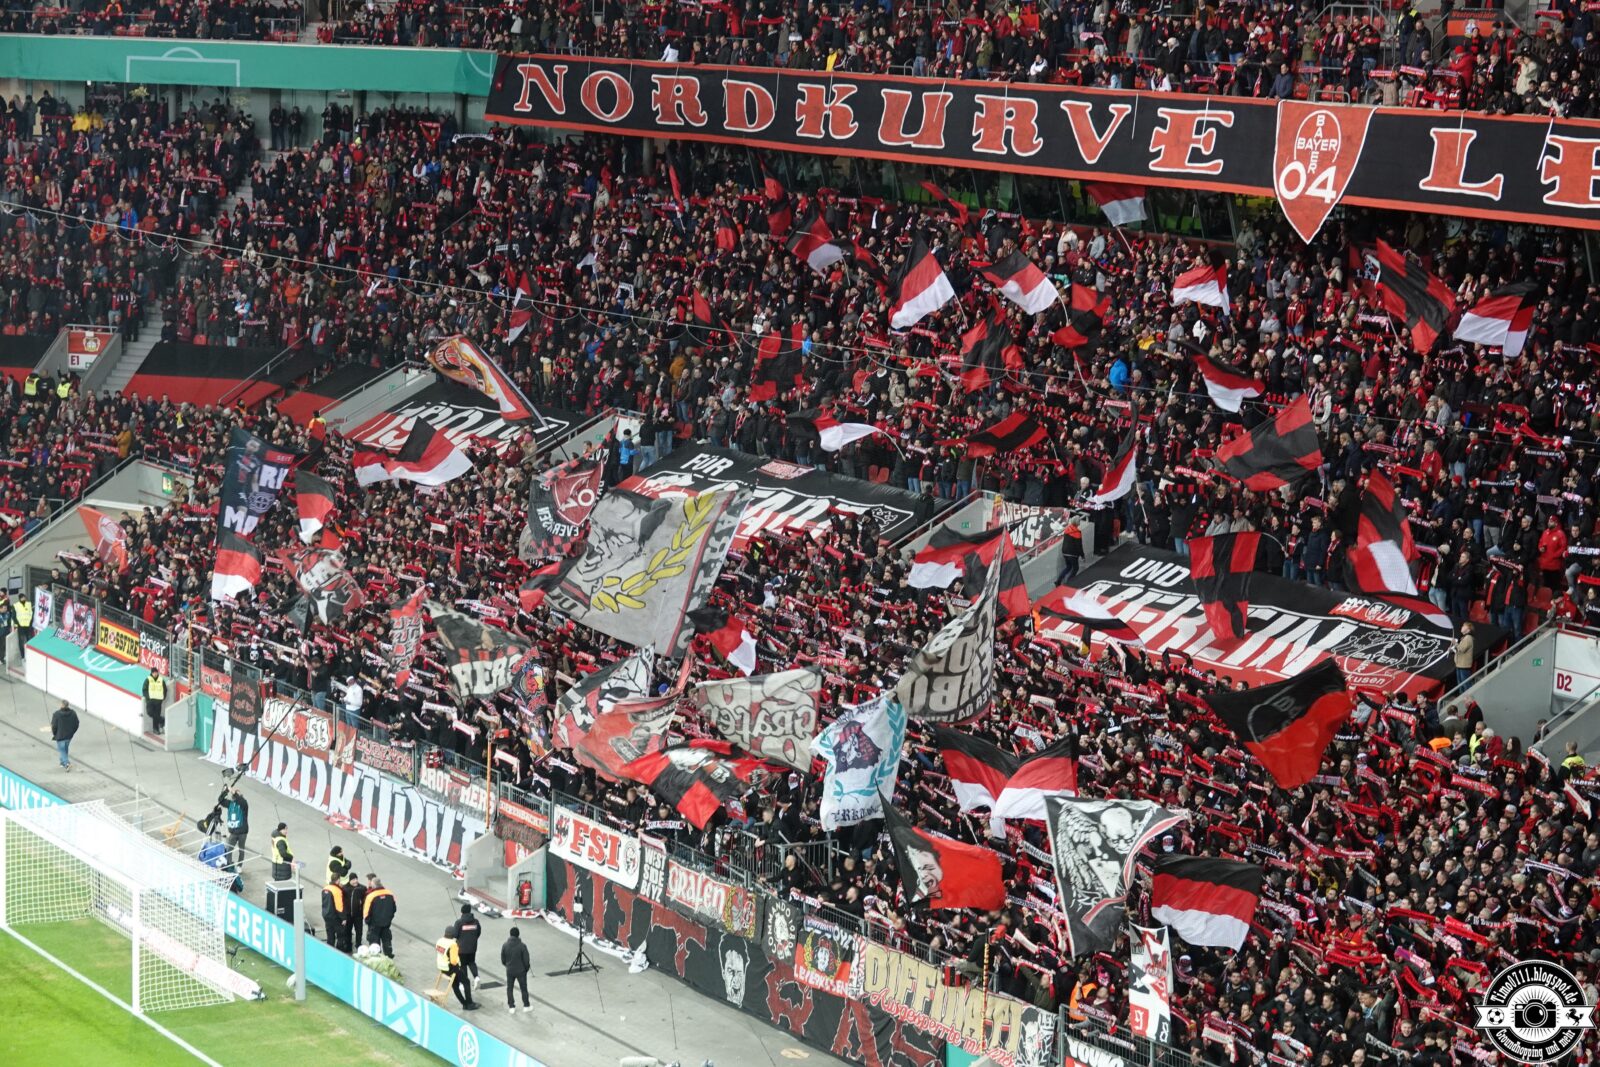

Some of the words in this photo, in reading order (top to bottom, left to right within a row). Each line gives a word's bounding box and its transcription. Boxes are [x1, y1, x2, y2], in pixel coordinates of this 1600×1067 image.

[513, 63, 1234, 174] NORDKURVE
[1296, 137, 1338, 151] BAYER
[1279, 161, 1337, 204] 04
[680, 453, 734, 477] FÜR
[1120, 557, 1191, 588] UND
[1556, 672, 1573, 692] D2
[570, 818, 620, 872] FSI
[644, 847, 666, 871] WEST
[642, 866, 665, 888] SIDE
